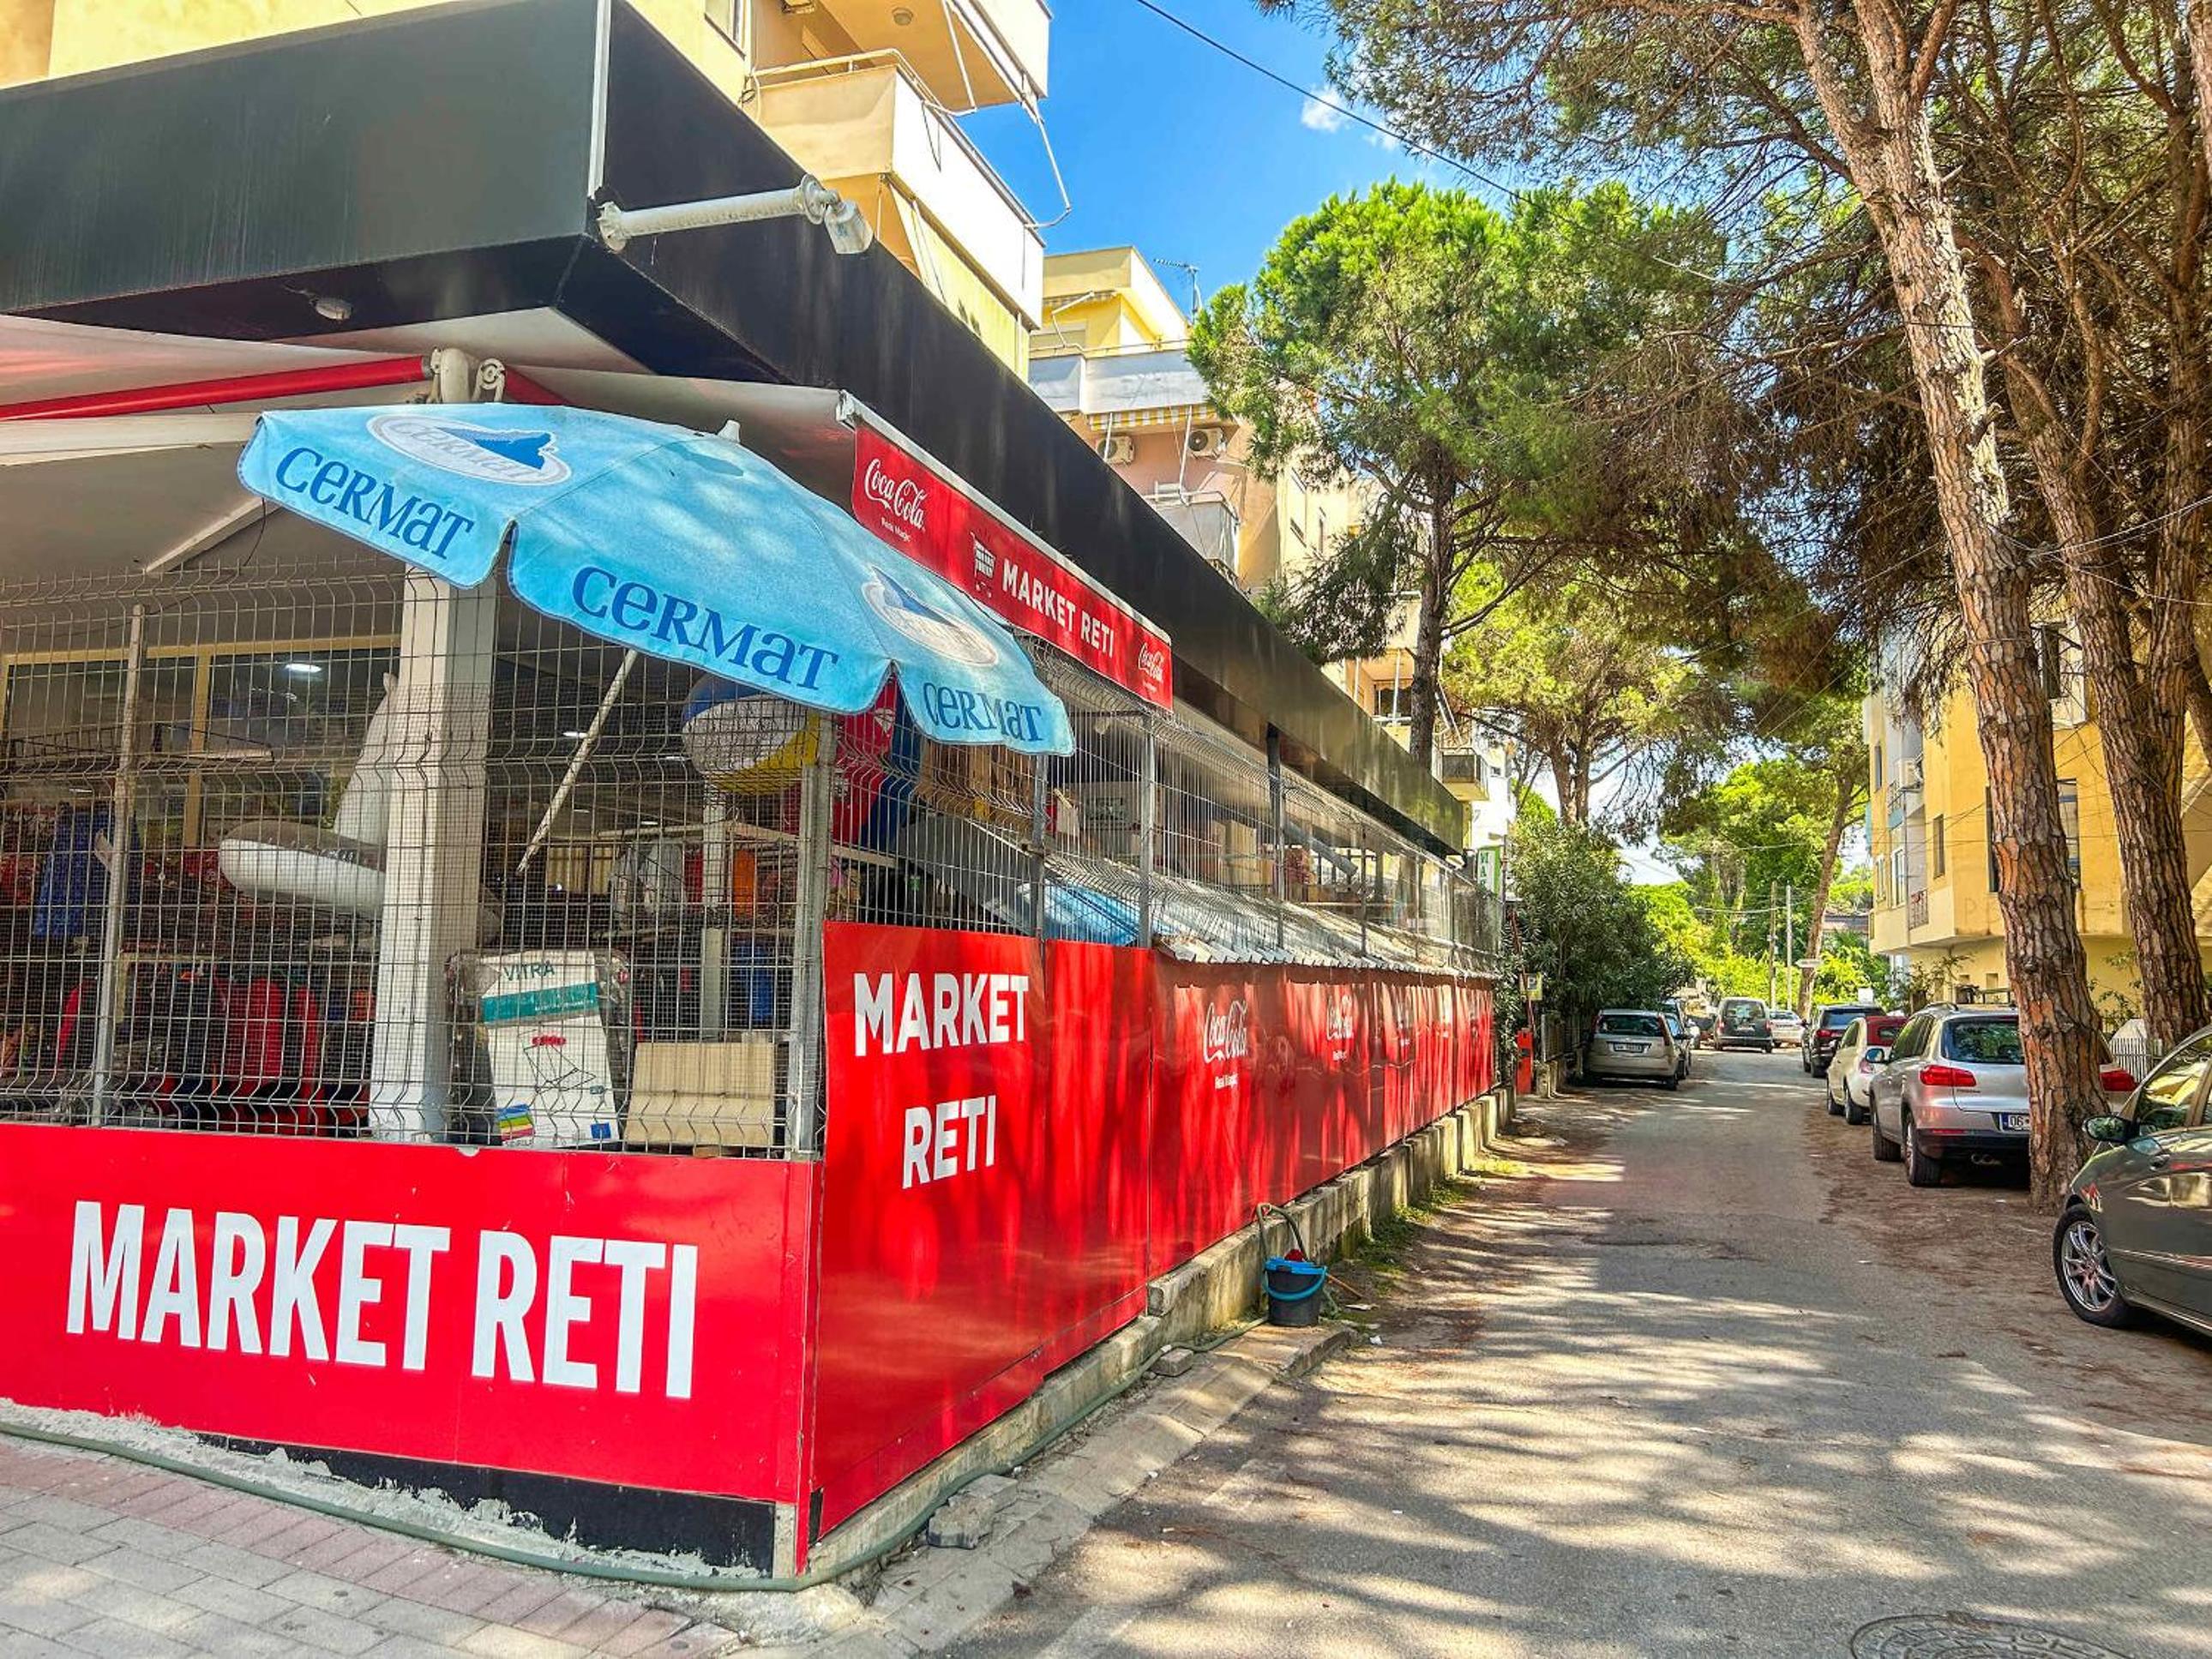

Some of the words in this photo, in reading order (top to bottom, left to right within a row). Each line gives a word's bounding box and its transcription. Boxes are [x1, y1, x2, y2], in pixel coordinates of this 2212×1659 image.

[1001, 558, 1076, 632] MARKET
[1080, 610, 1114, 658] RETI
[854, 972, 1029, 1057] MARKET
[902, 1094, 996, 1189] RETI
[65, 1199, 451, 1372] MARKET
[472, 1229, 699, 1399] RETI
